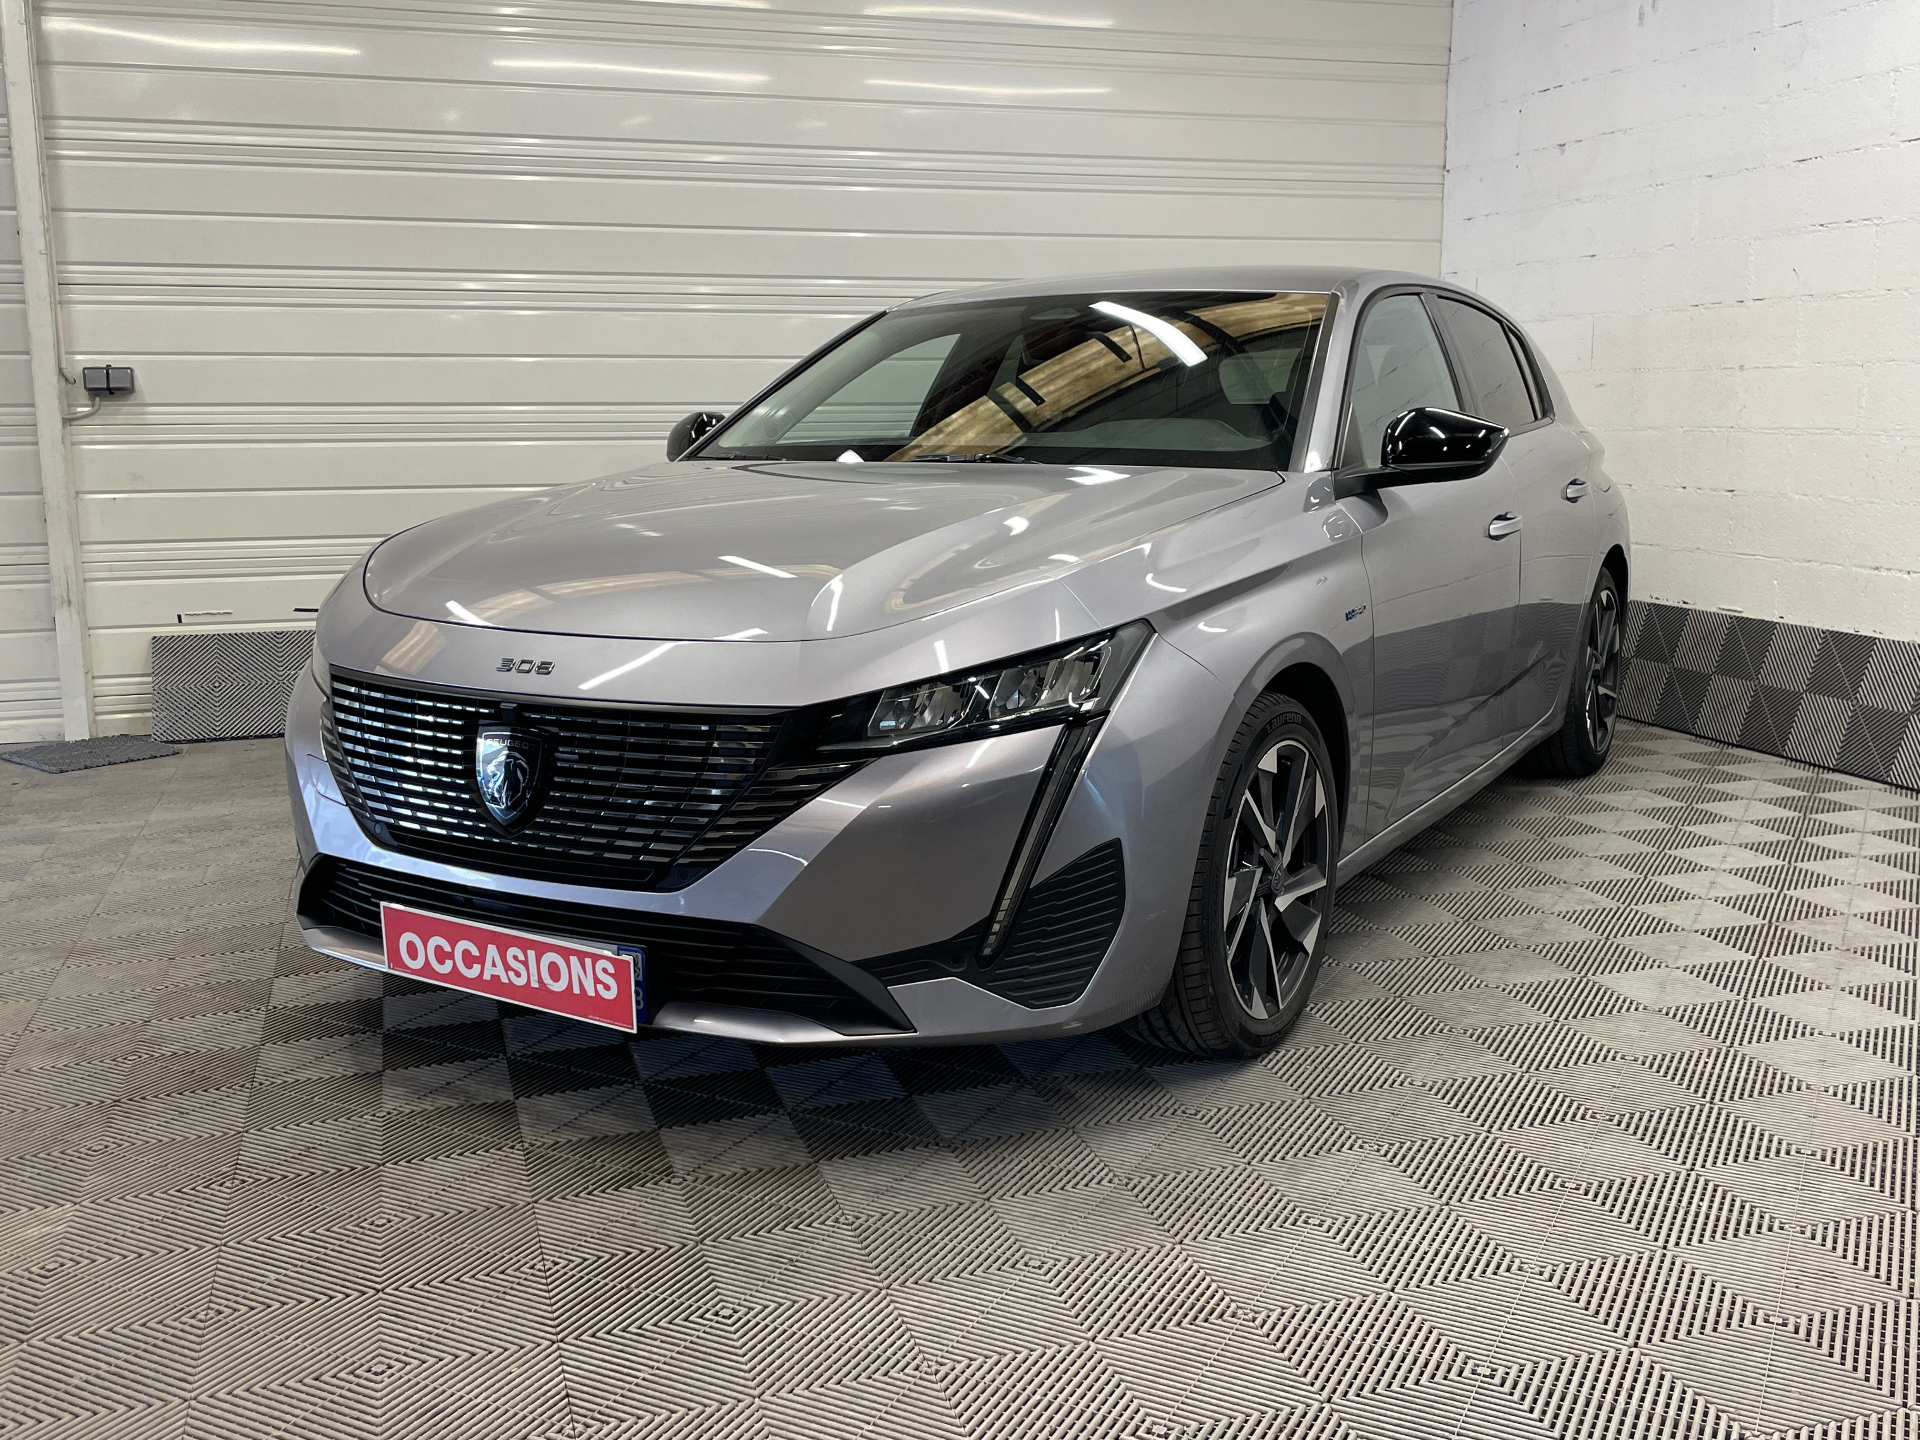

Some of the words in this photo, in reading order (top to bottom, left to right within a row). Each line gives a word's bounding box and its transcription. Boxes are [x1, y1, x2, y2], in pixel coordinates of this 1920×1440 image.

[496, 658, 555, 675] 308
[485, 739, 537, 750] PEUGEOT
[399, 931, 618, 1000] OCCASIONS
